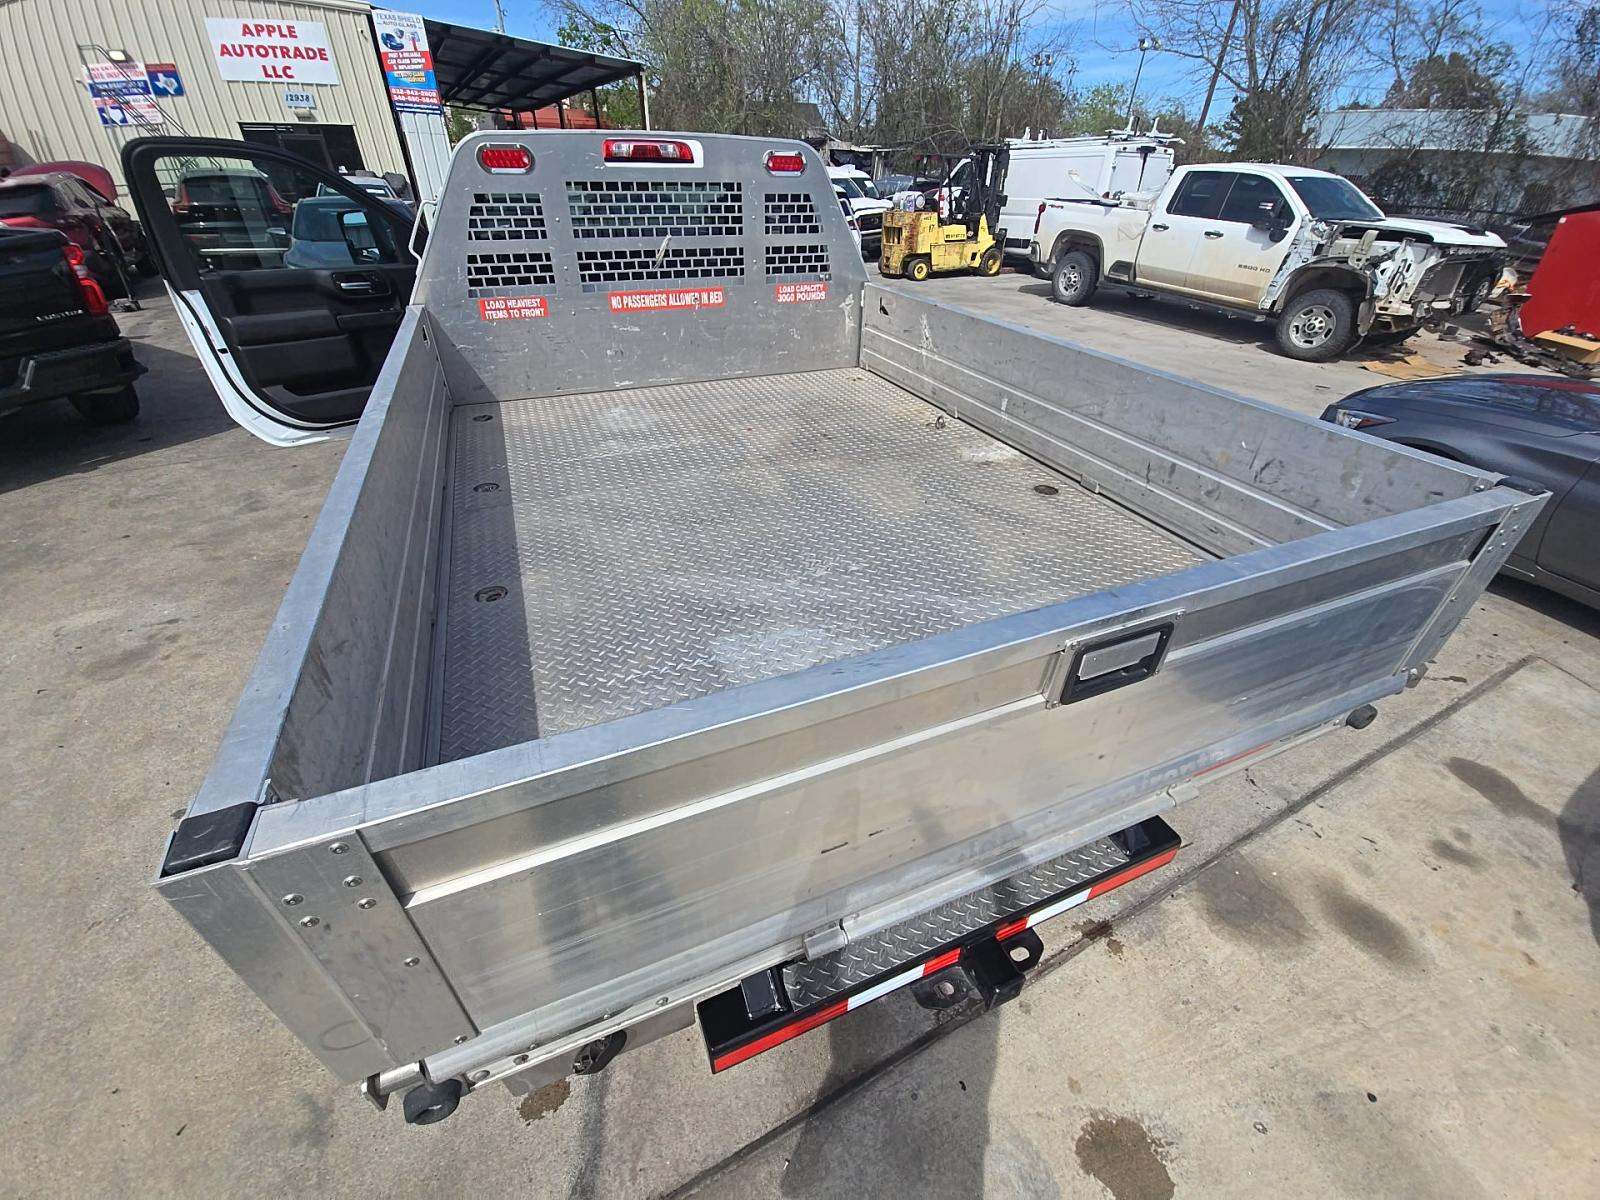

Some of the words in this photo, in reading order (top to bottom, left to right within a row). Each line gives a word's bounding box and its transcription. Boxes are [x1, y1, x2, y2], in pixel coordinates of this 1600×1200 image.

[241, 23, 298, 39] APPLE
[219, 43, 329, 61] AUTOTRADE
[261, 64, 295, 79] LLC
[285, 93, 310, 102] 12938
[779, 285, 795, 293] LOAD
[796, 283, 824, 292] CAPACITY
[610, 295, 621, 309] NO
[623, 294, 667, 308] PASSENGERS
[701, 291, 709, 304] IN
[710, 291, 723, 304] BED
[796, 291, 826, 301] POUNDS
[485, 300, 506, 310] LOAD
[506, 298, 541, 308] HEAVIEST
[485, 309, 509, 320] ITEMS
[509, 309, 520, 319] TO
[521, 307, 545, 318] FRONT
